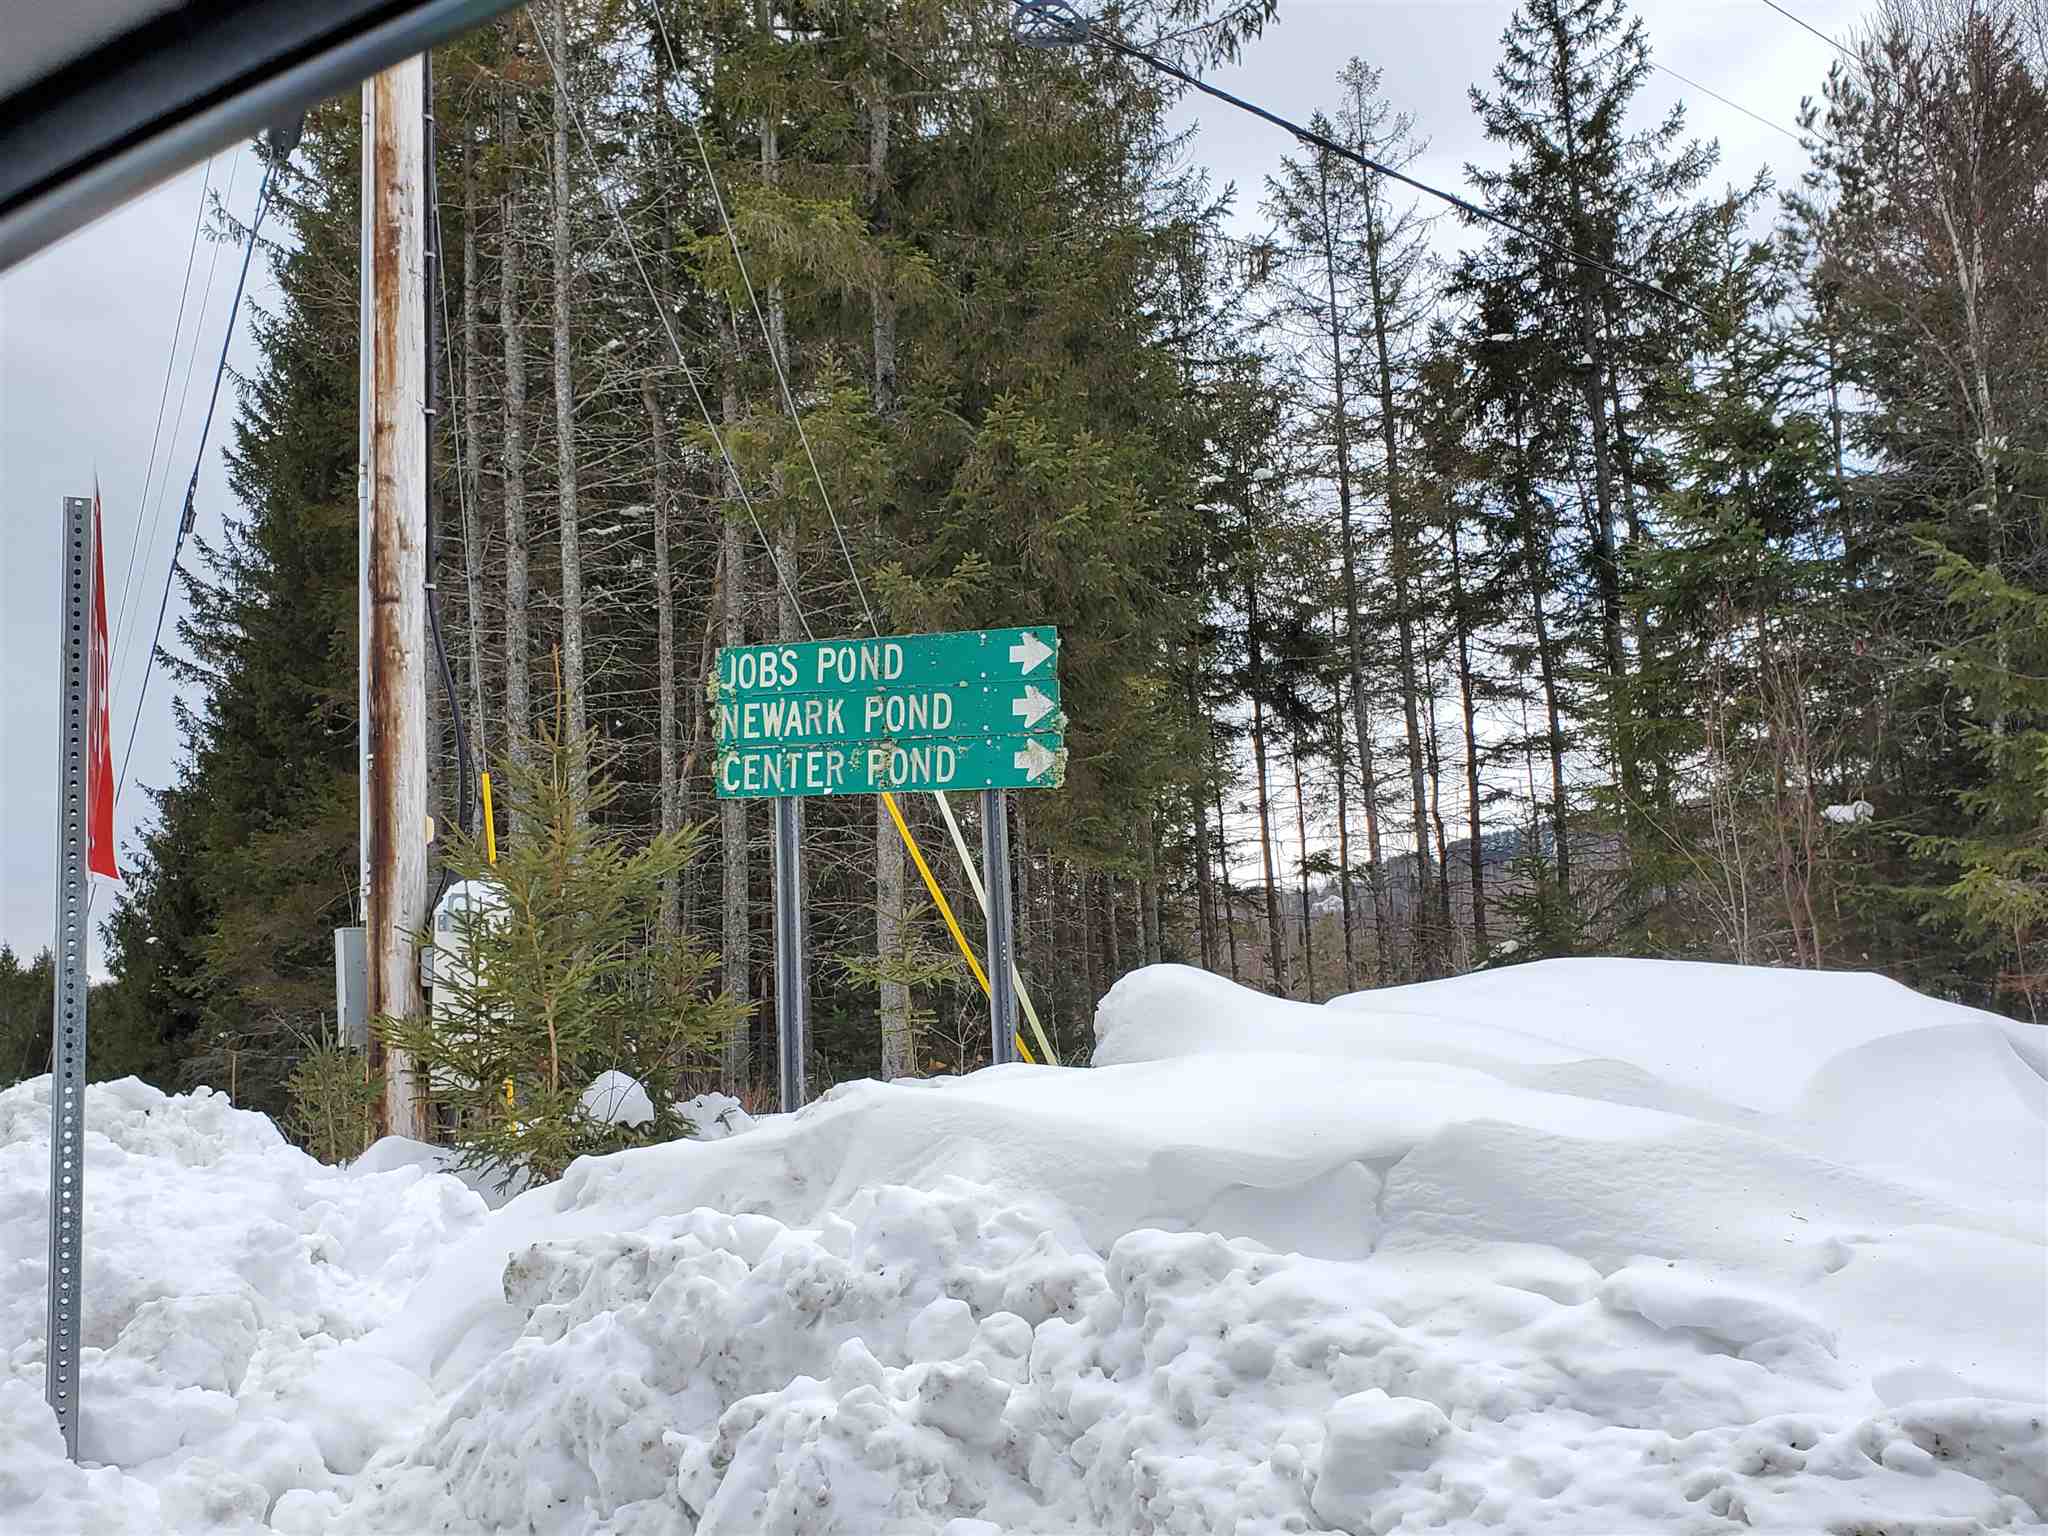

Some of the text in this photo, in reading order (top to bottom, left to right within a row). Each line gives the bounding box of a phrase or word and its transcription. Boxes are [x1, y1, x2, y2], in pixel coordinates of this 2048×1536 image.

[721, 644, 903, 689] JOBS POND
[720, 693, 952, 739] NEWARK POND
[723, 746, 955, 791] CENTER POND
